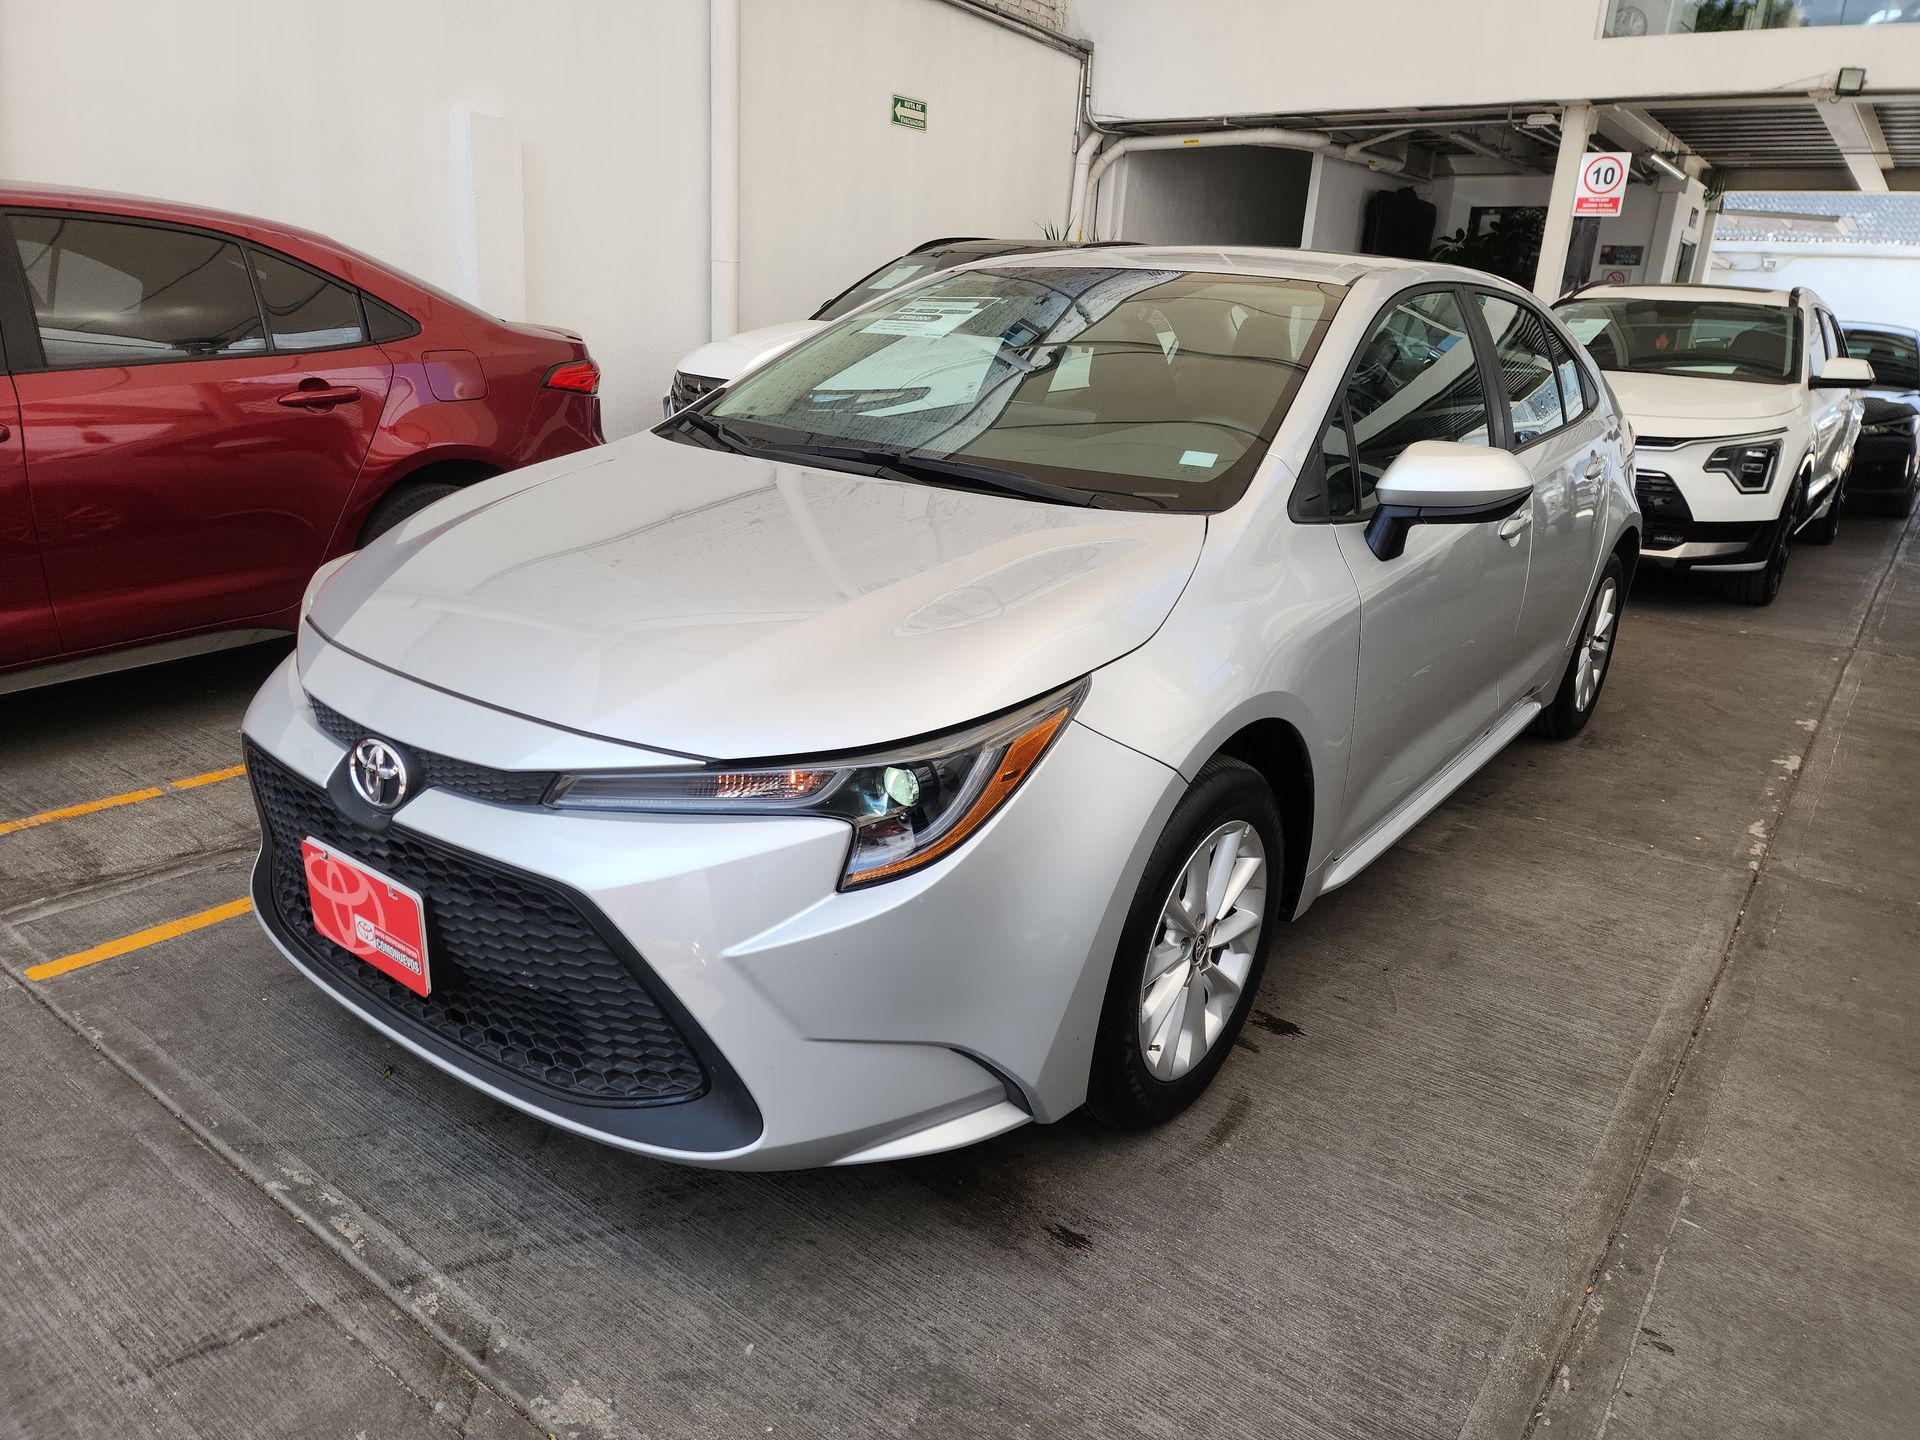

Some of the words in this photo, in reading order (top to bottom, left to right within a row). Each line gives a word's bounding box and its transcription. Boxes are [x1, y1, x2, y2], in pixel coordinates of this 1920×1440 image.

[904, 101, 915, 109] RUTA
[916, 103, 922, 111] DE
[1592, 167, 1615, 185] 10
[375, 938, 420, 973] COMONUEVOS
